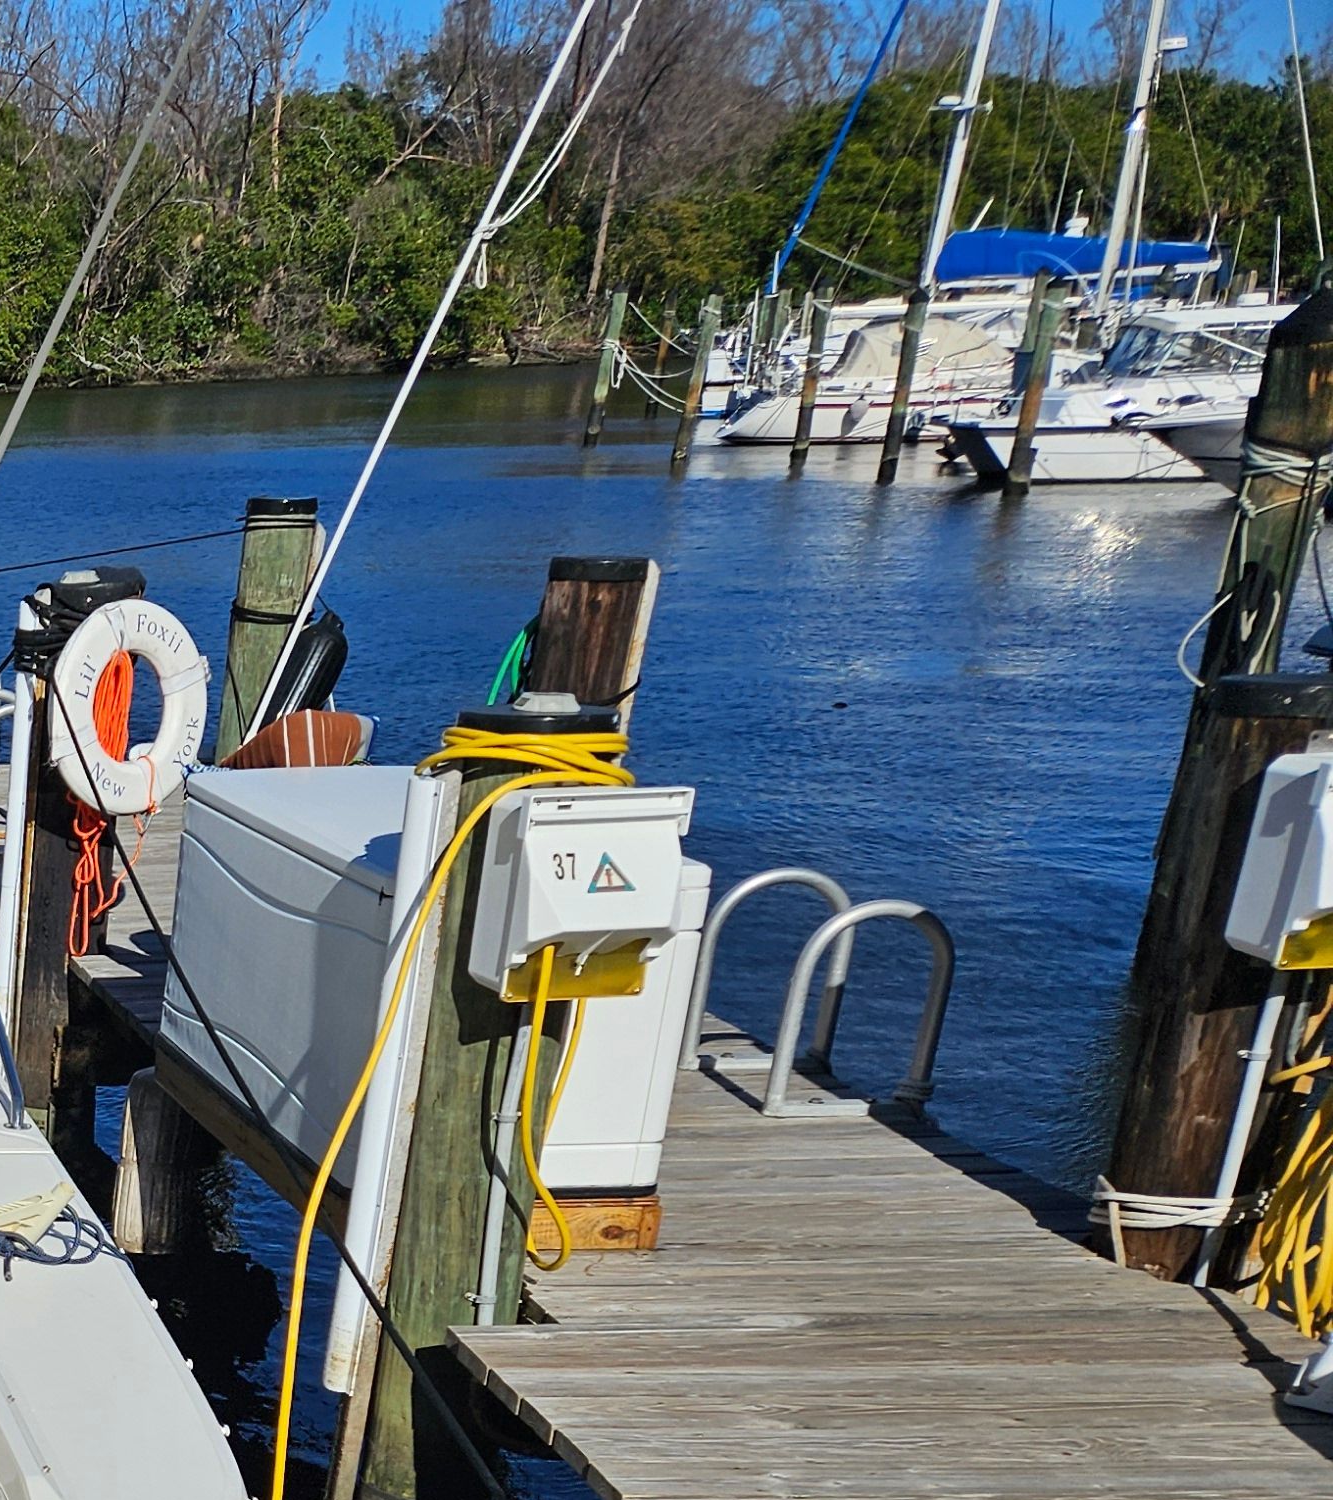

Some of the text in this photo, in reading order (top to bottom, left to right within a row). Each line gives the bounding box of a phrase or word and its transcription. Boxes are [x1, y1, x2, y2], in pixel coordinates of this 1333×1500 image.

[74, 613, 184, 700] Lil' Foxii
[91, 717, 200, 798] New York
[552, 852, 576, 880] 37
